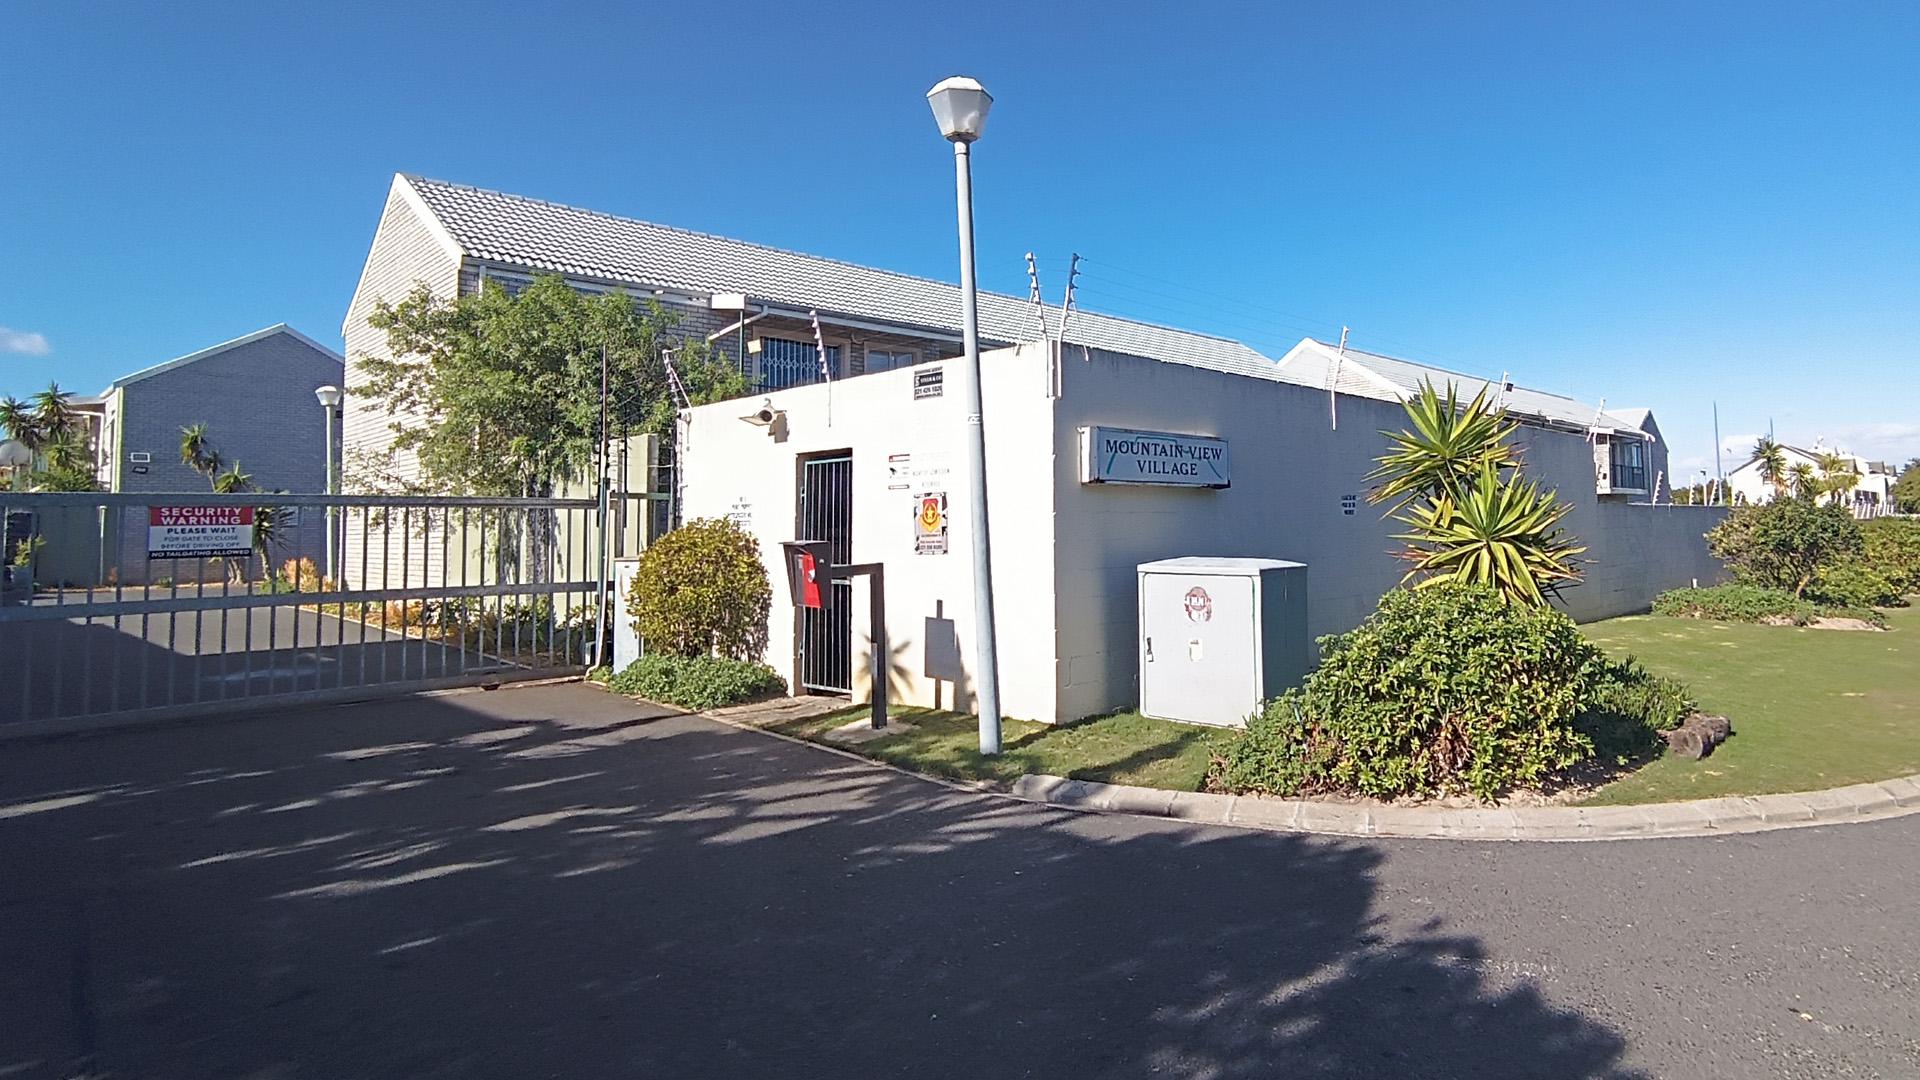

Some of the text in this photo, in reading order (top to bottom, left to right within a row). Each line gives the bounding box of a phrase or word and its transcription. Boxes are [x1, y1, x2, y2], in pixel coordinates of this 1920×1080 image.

[1105, 439, 1223, 461] MOUNTAIN VIEW
[1136, 459, 1199, 476] VILLAGE
[161, 507, 242, 516] SECURITY
[161, 516, 242, 525] WARNING
[167, 526, 237, 535] PLEASE WAIT
